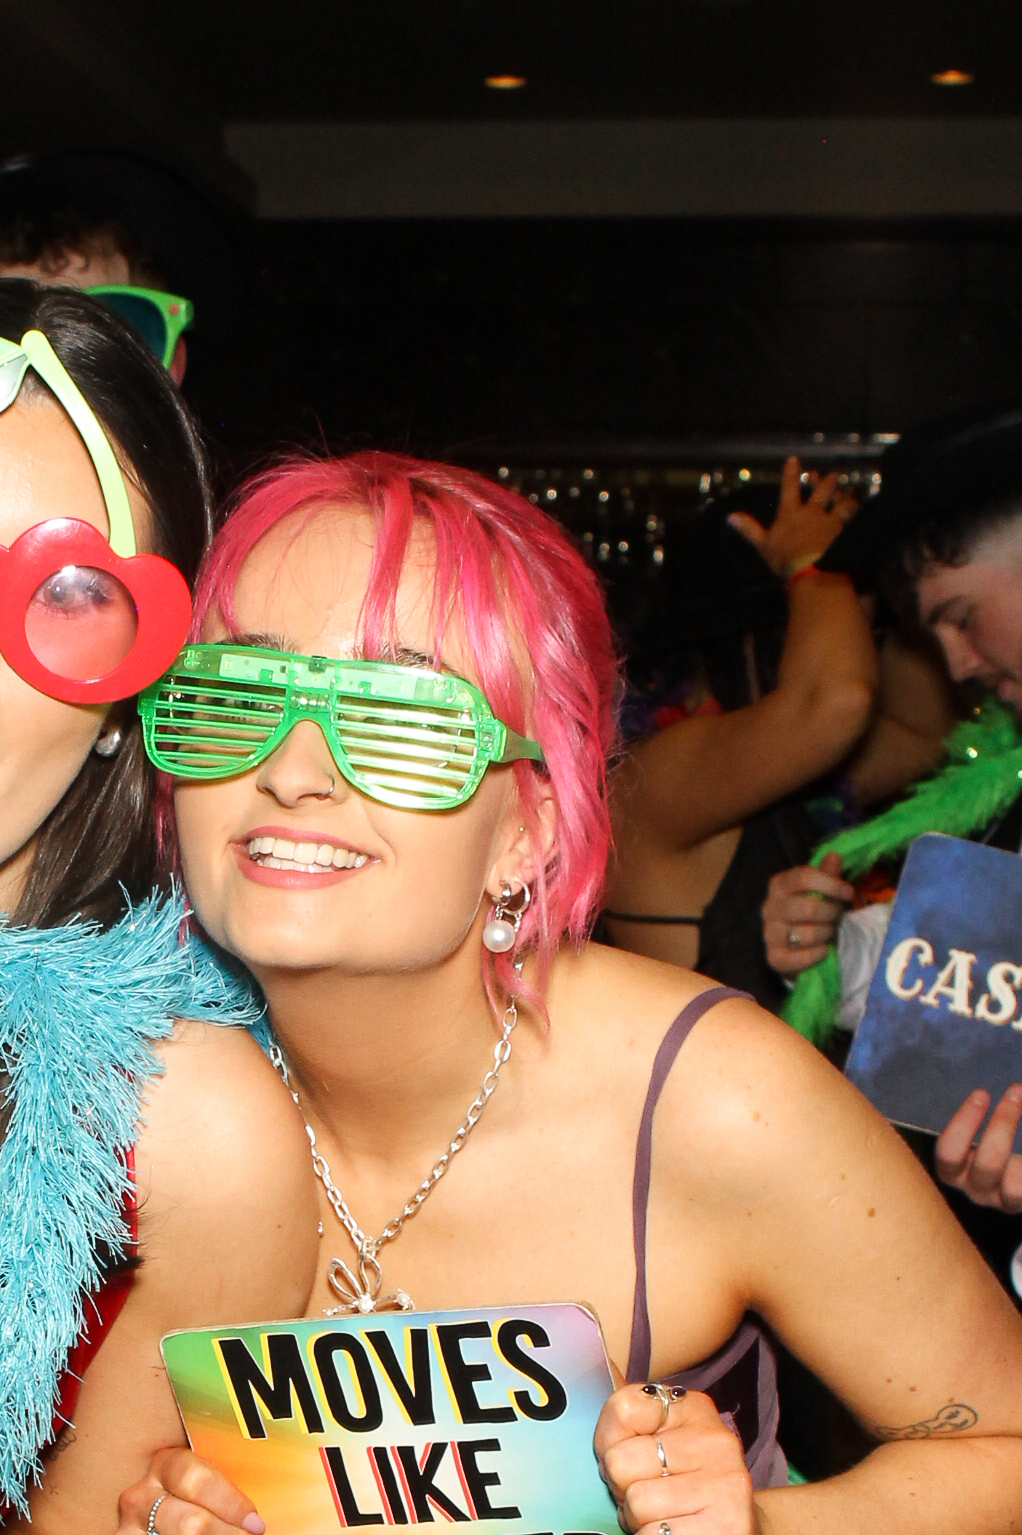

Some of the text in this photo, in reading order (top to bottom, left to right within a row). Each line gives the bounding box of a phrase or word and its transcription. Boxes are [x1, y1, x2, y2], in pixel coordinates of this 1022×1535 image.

[885, 937, 1022, 1031] CAS
[214, 1319, 568, 1439] MOVES
[319, 1438, 522, 1528] LIKE
